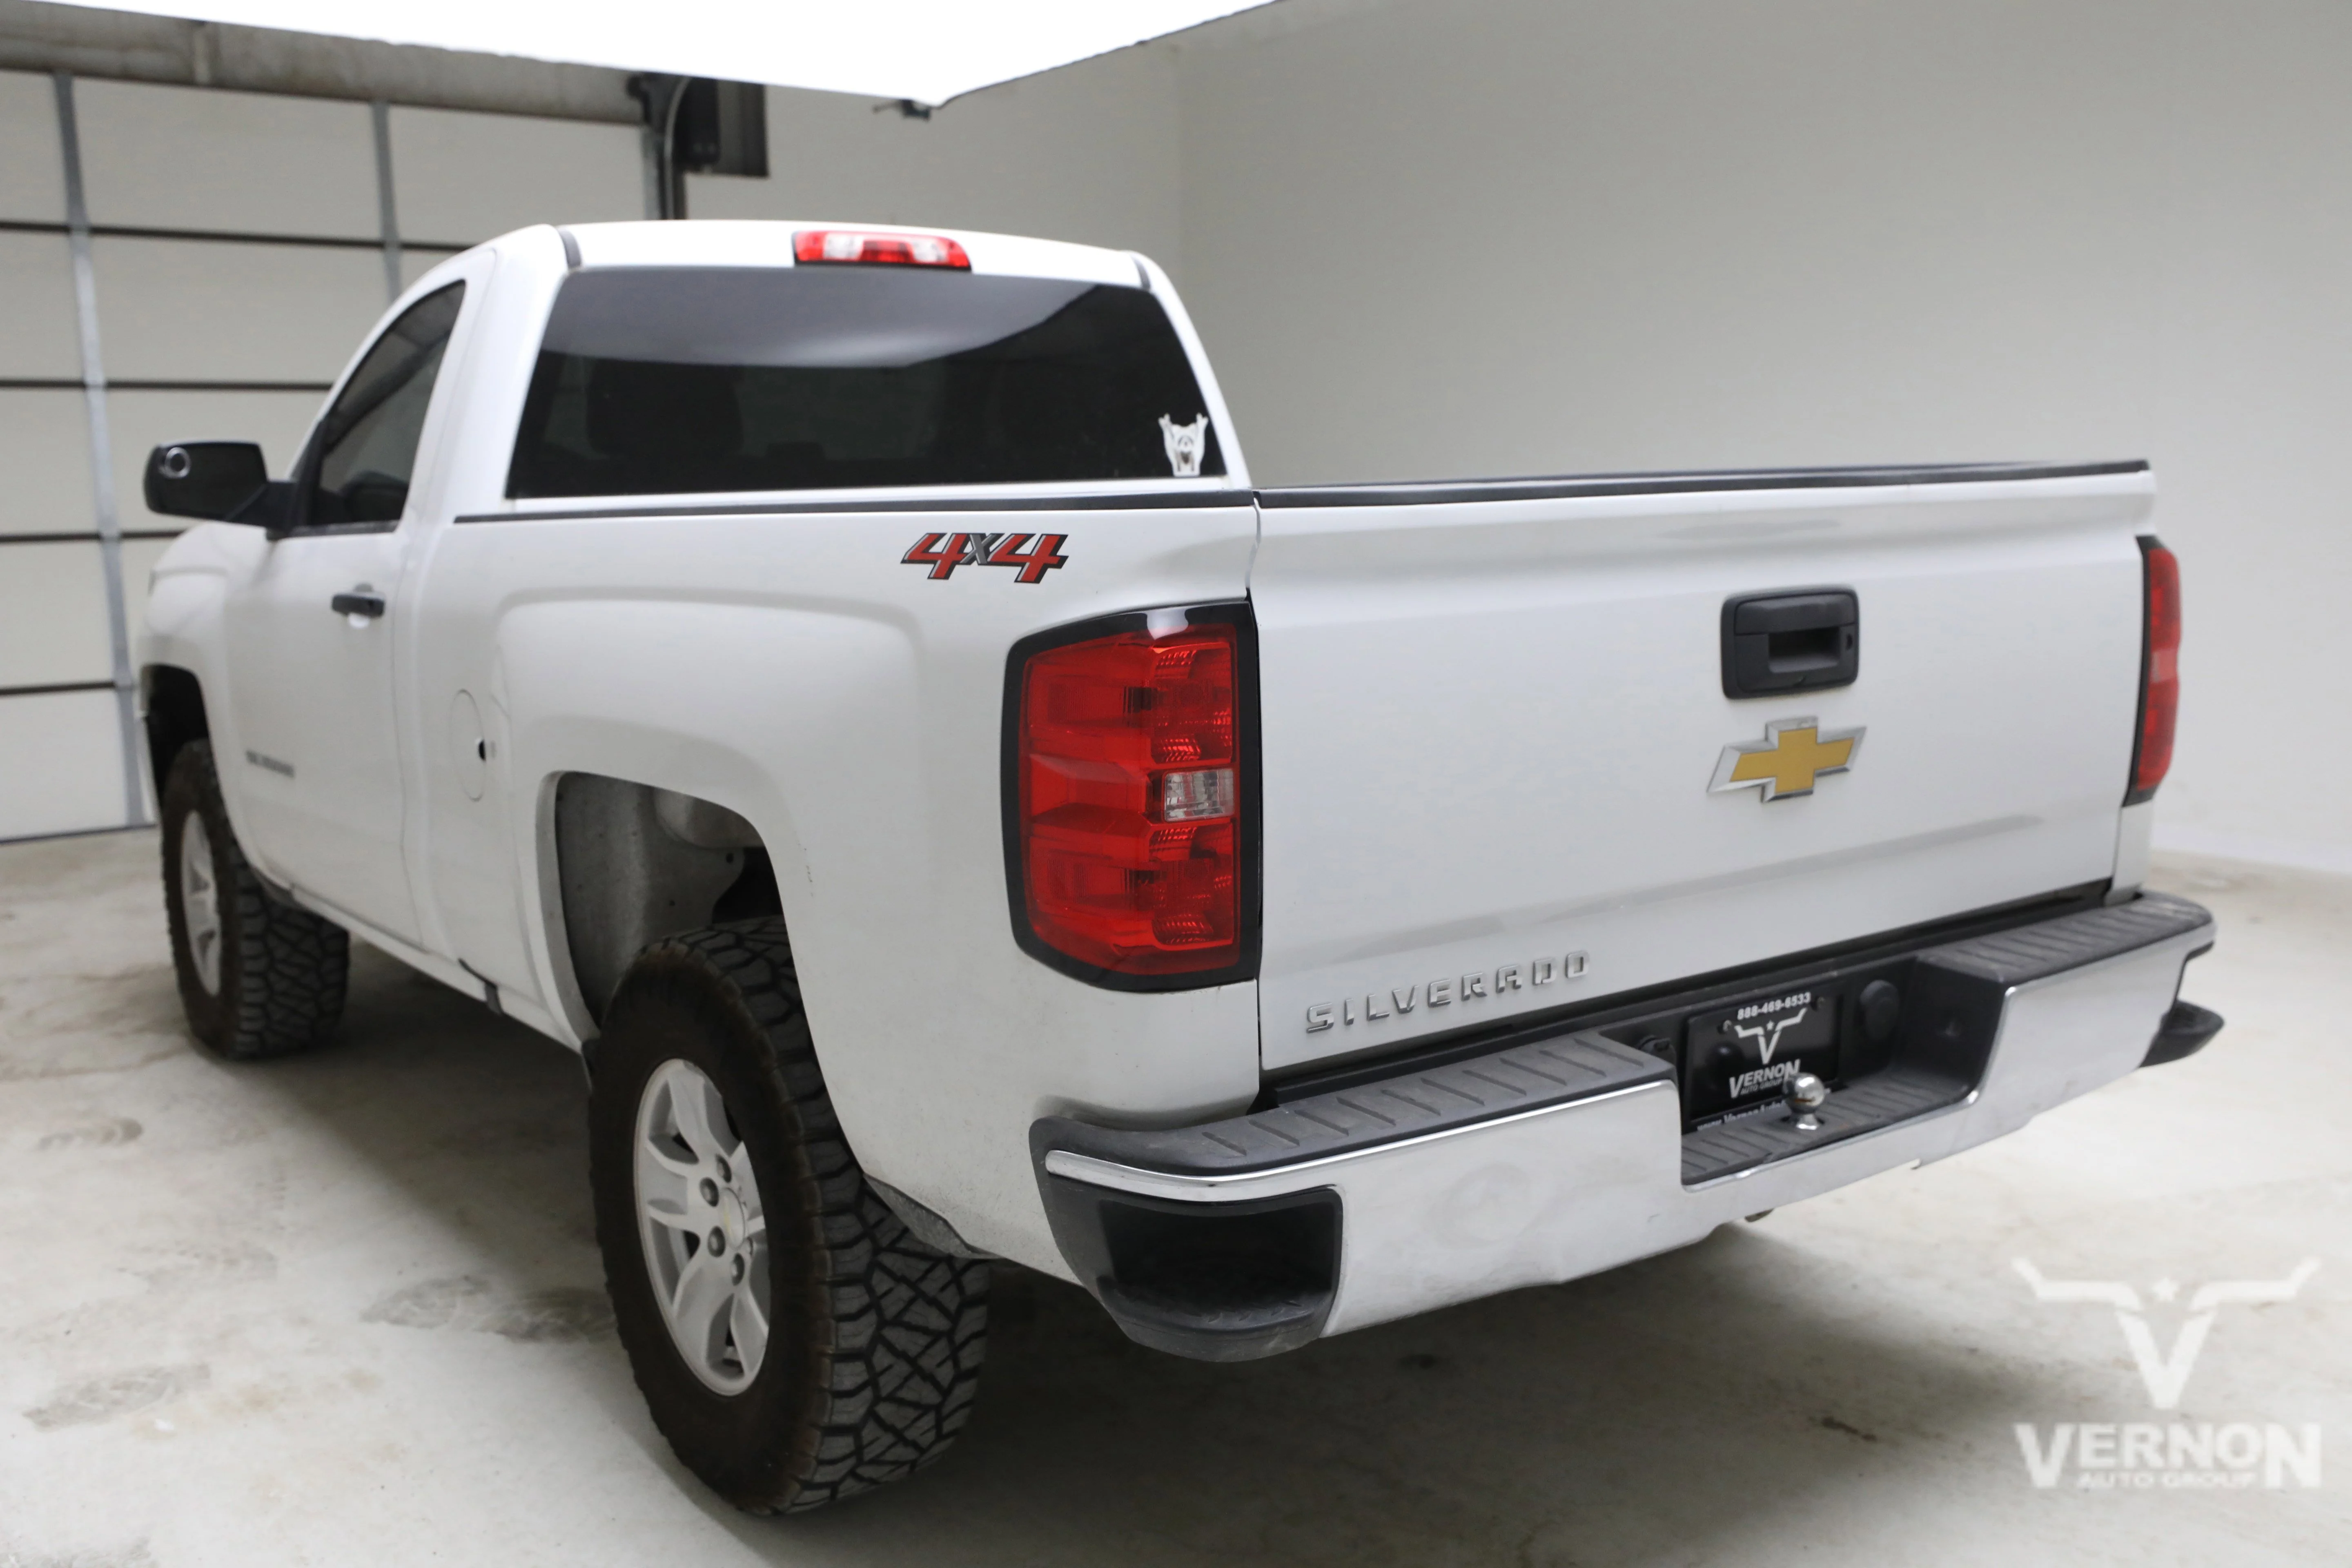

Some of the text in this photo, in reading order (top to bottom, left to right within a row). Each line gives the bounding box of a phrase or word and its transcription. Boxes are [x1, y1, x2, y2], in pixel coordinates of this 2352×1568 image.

[1307, 950, 1590, 1033] SILVERADO
[1737, 992, 1811, 1020] 888-469-6533
[1729, 1058, 1800, 1098] VERNON
[1740, 1084, 1758, 1095] AUTO
